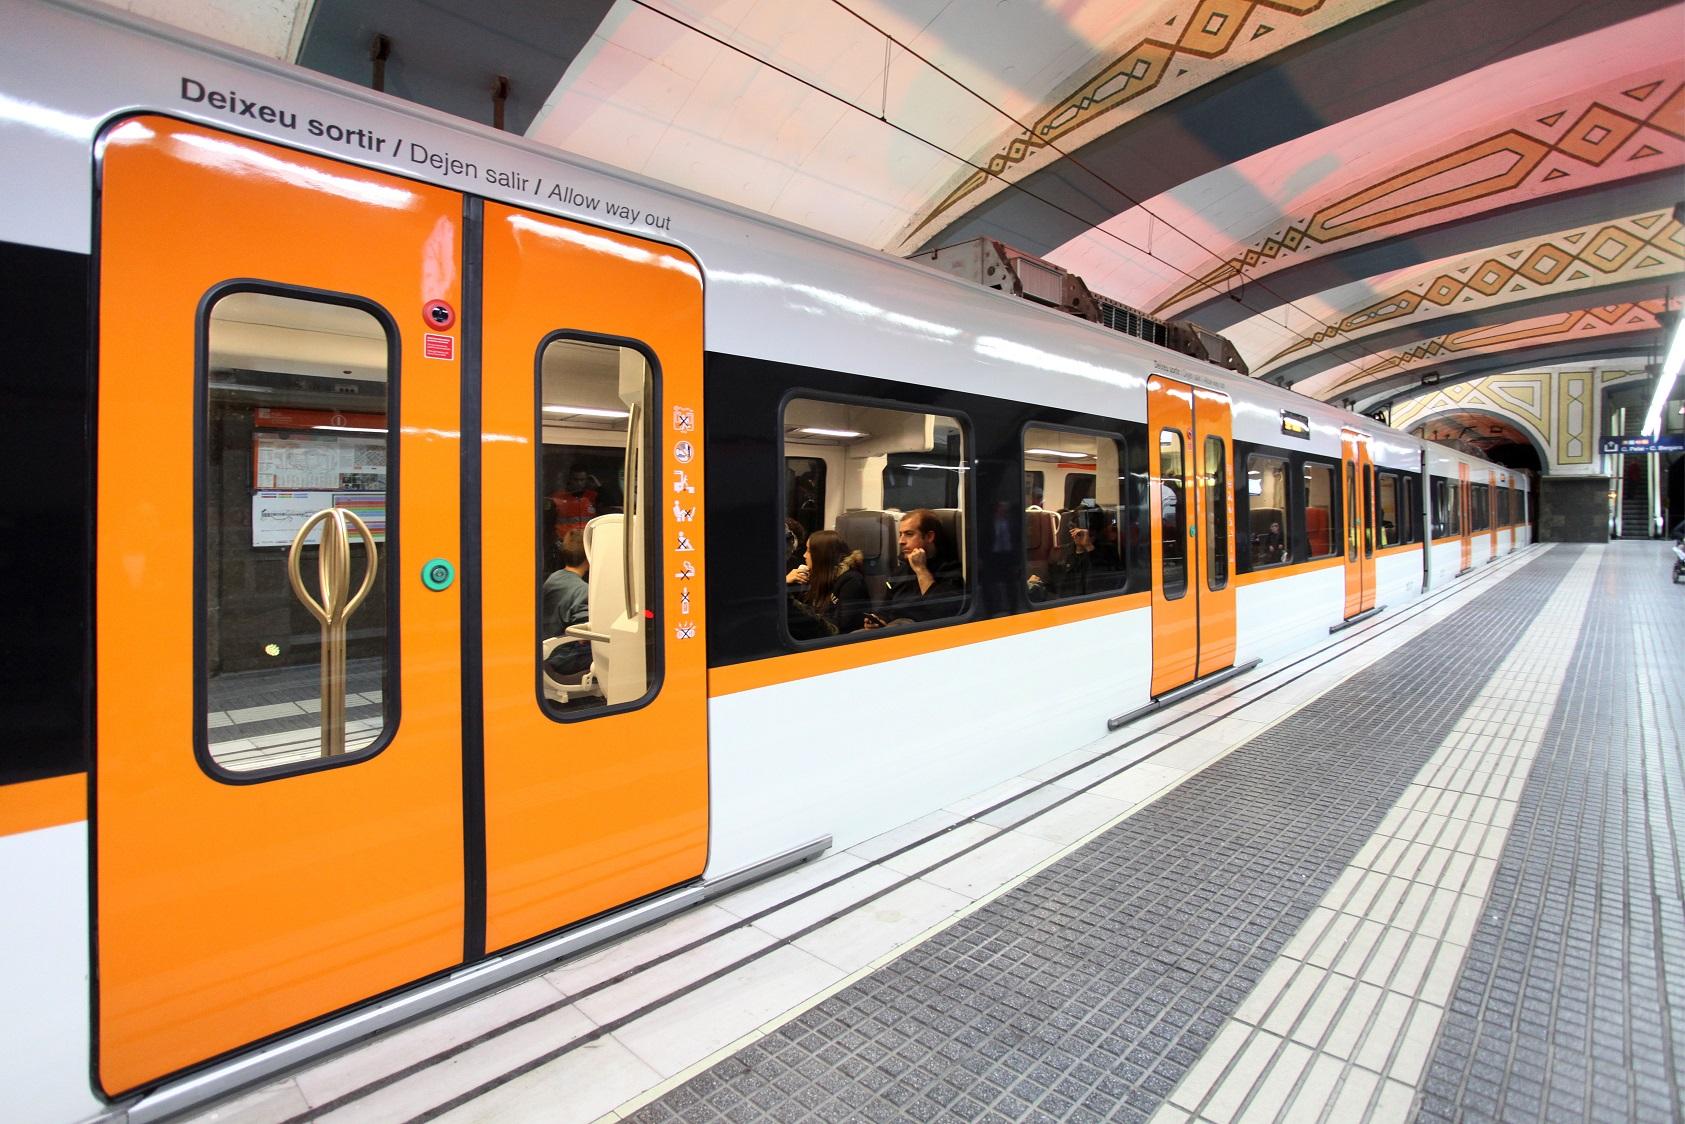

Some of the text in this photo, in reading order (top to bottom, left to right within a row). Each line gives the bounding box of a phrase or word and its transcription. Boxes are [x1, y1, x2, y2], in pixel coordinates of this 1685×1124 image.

[181, 77, 672, 231] Deixeu sortir / Dejen salir / Allow way out
